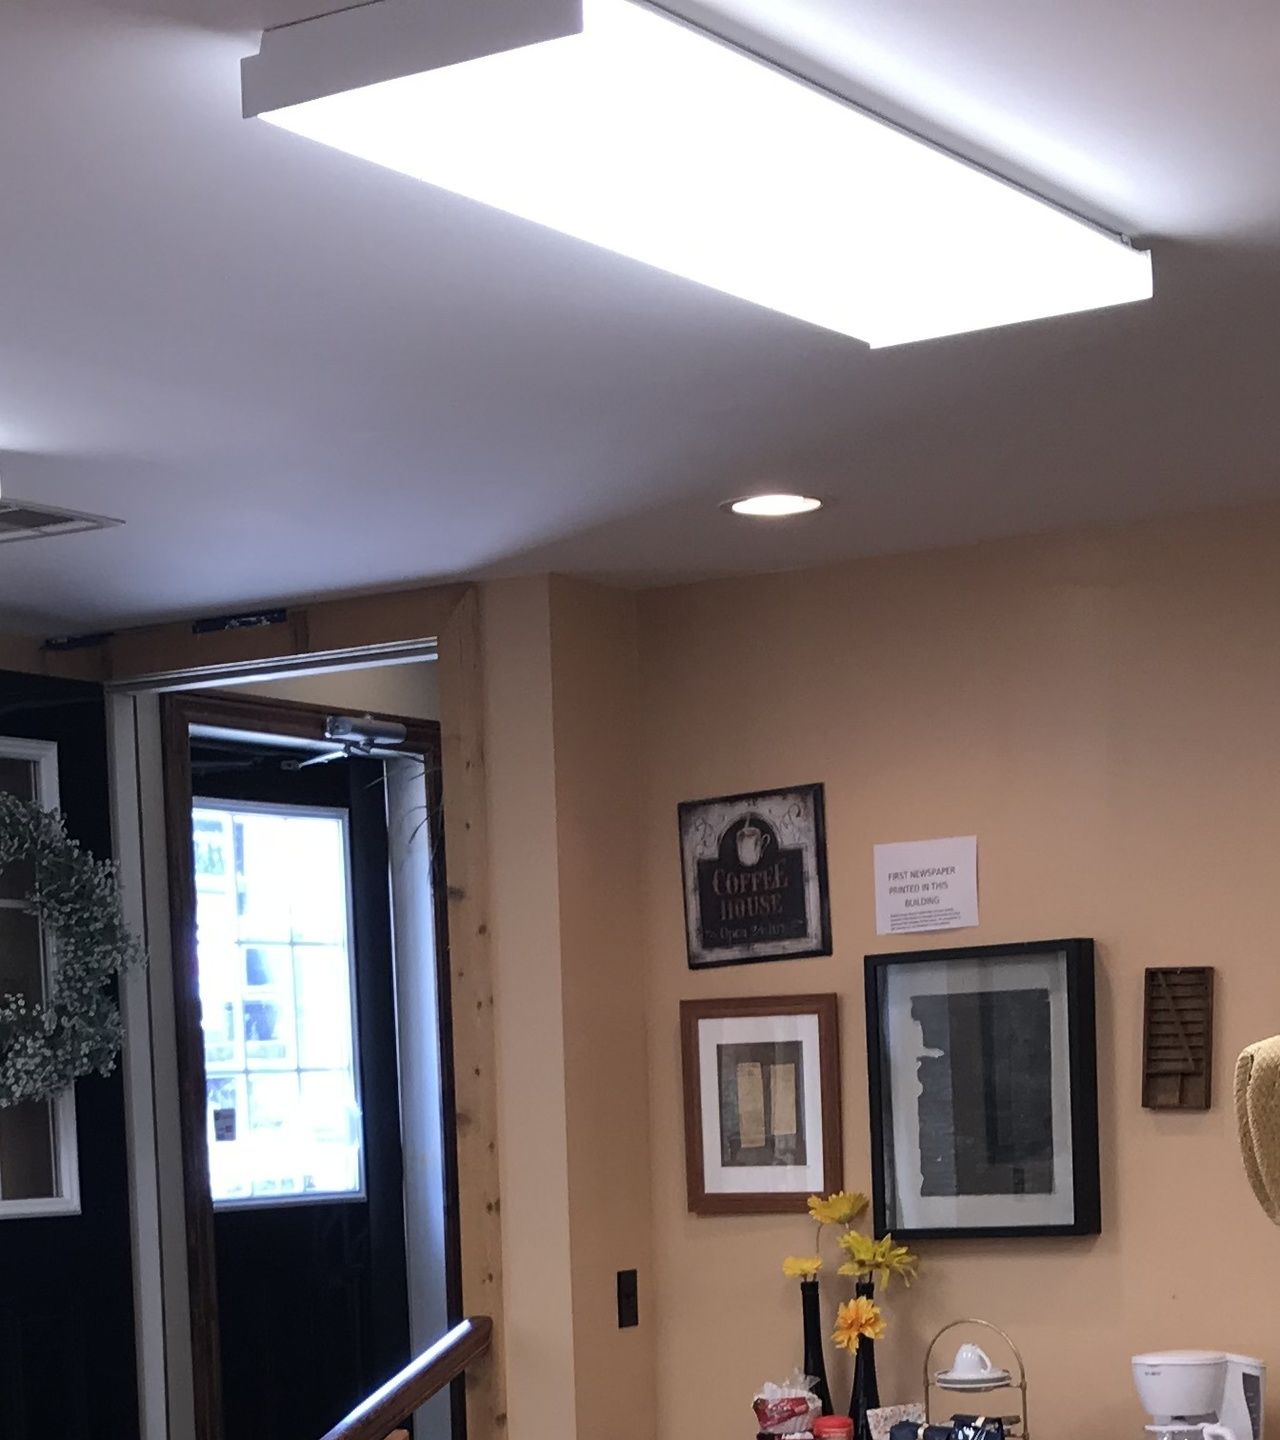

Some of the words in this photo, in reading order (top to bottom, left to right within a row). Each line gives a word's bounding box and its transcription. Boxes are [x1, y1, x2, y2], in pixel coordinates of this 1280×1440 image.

[712, 857, 788, 896] COFFEE
[888, 871, 908, 881] FIRST
[910, 866, 956, 879] NEWSPAPER
[888, 884, 920, 895] PRINTED
[922, 883, 930, 891] IN
[932, 881, 948, 890] THIS
[720, 894, 784, 921] HOUSE
[904, 896, 940, 907] BUILDING
